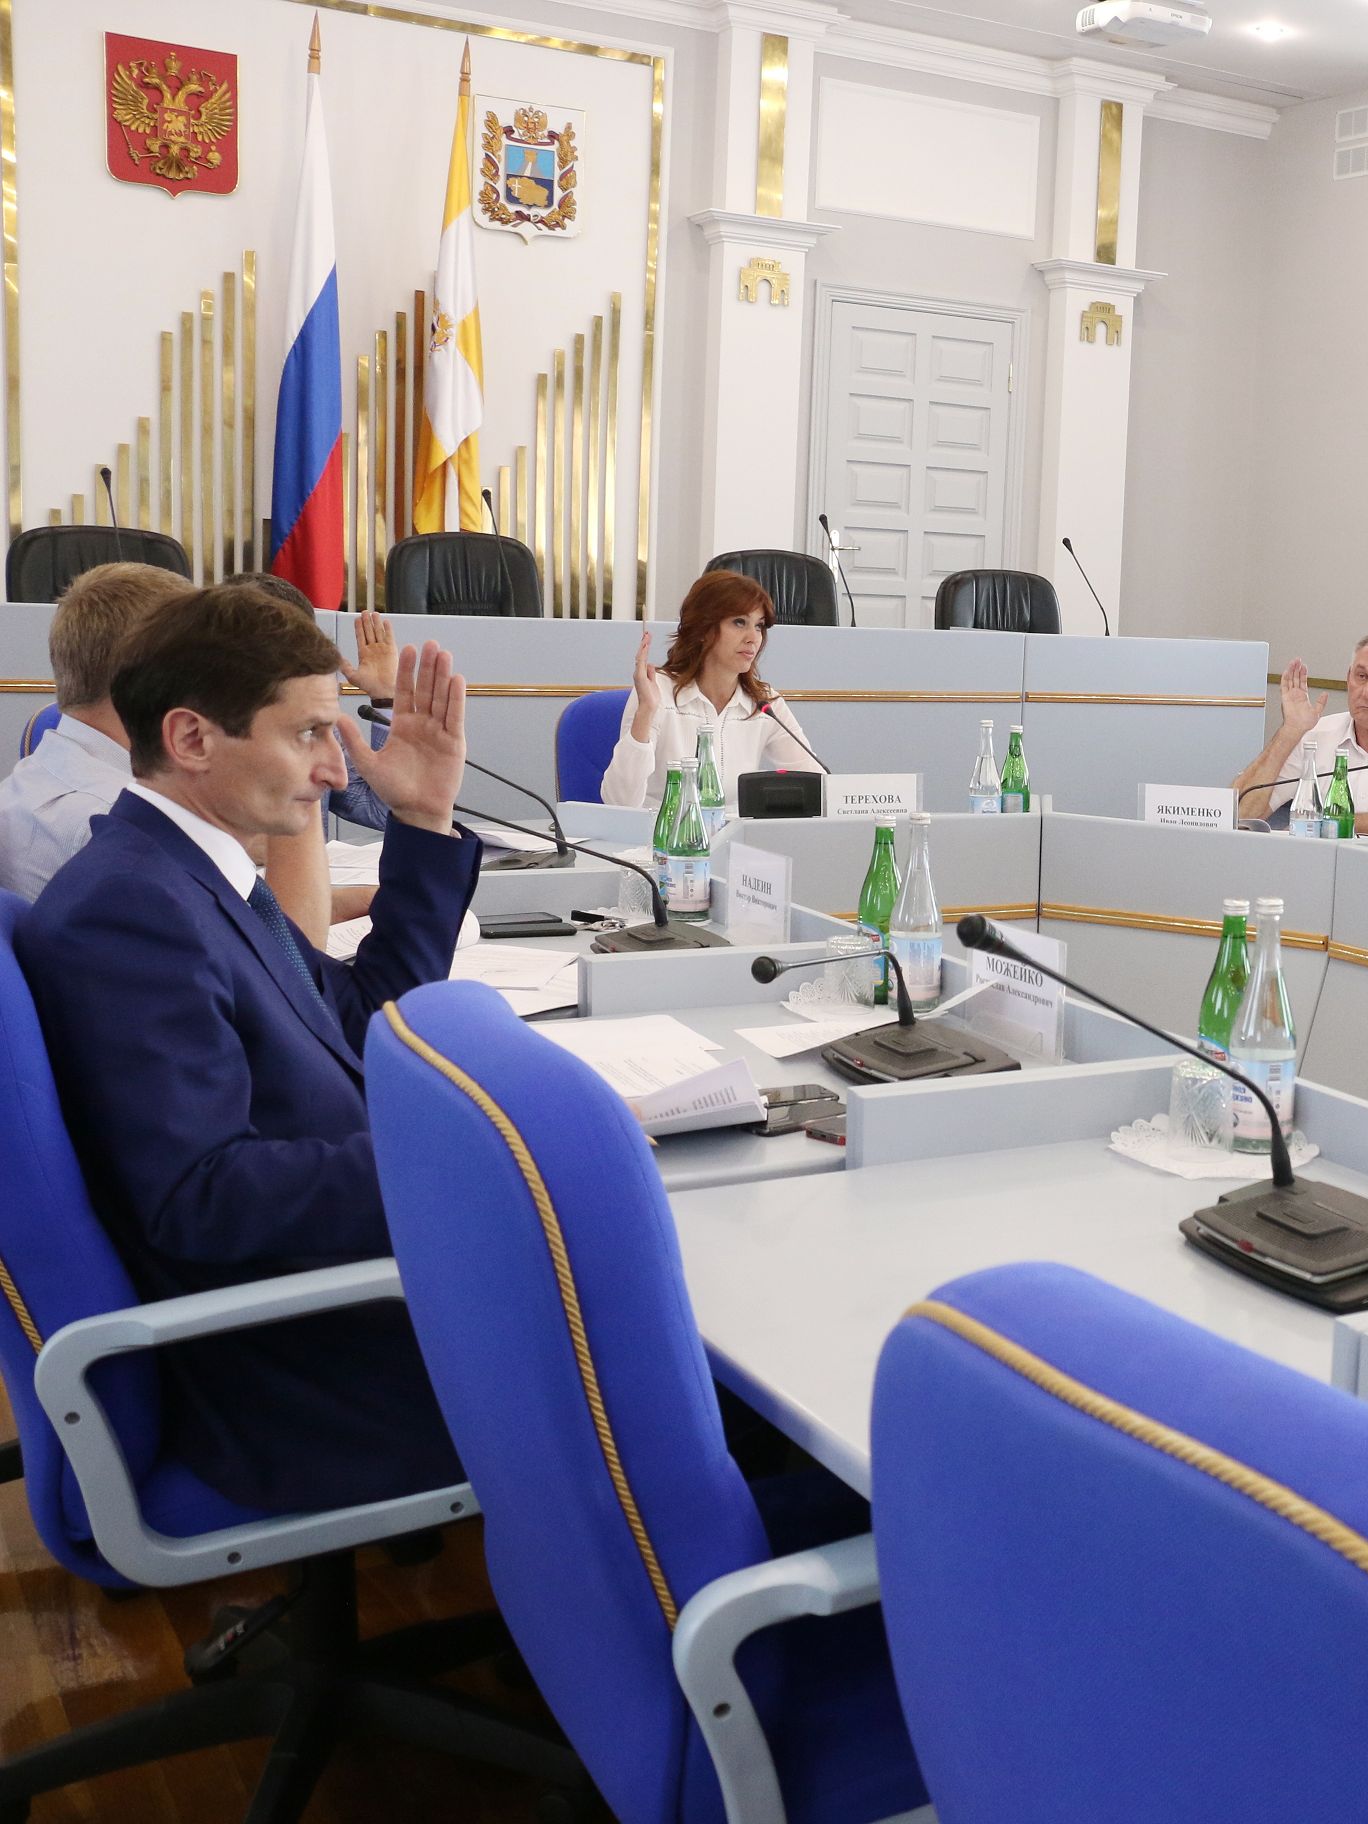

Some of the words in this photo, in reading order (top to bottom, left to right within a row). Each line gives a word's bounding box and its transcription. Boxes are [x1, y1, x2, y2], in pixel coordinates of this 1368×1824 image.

[843, 794, 902, 805] ТЕРЕХОВА
[1157, 805, 1222, 818] ЯКИМЕНКО
[986, 956, 1044, 987] МОЖЕЙКО
